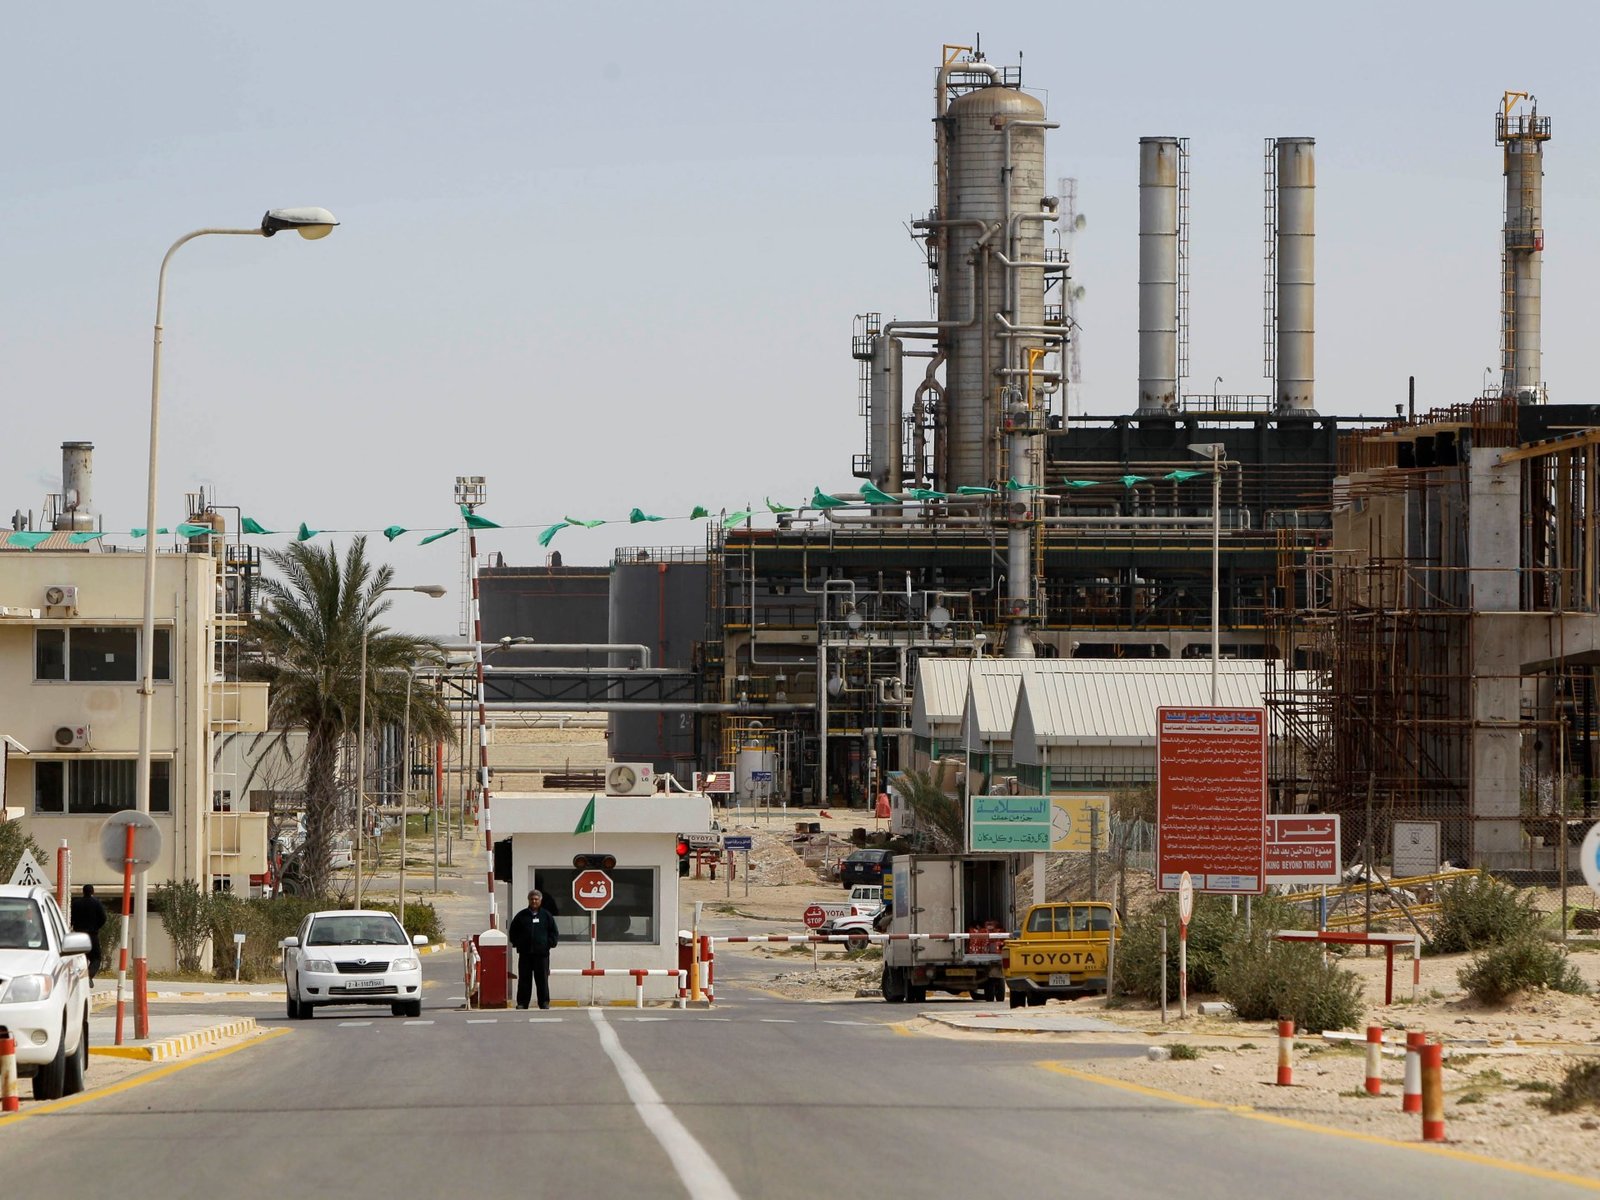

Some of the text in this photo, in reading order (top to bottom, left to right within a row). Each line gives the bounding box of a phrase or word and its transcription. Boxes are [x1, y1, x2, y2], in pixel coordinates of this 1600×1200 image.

[976, 799, 1047, 814] السلامة
[1281, 823, 1332, 839] خطر
[1280, 847, 1290, 857] بعد
[1290, 845, 1315, 858] التدخين
[1314, 846, 1332, 857] ممنوع
[1266, 860, 1332, 869] KING BEYOND THIS POINT
[579, 880, 607, 898] قف
[807, 908, 822, 916] قف
[807, 917, 823, 925] STOP
[1021, 953, 1096, 966] TOYOTA
